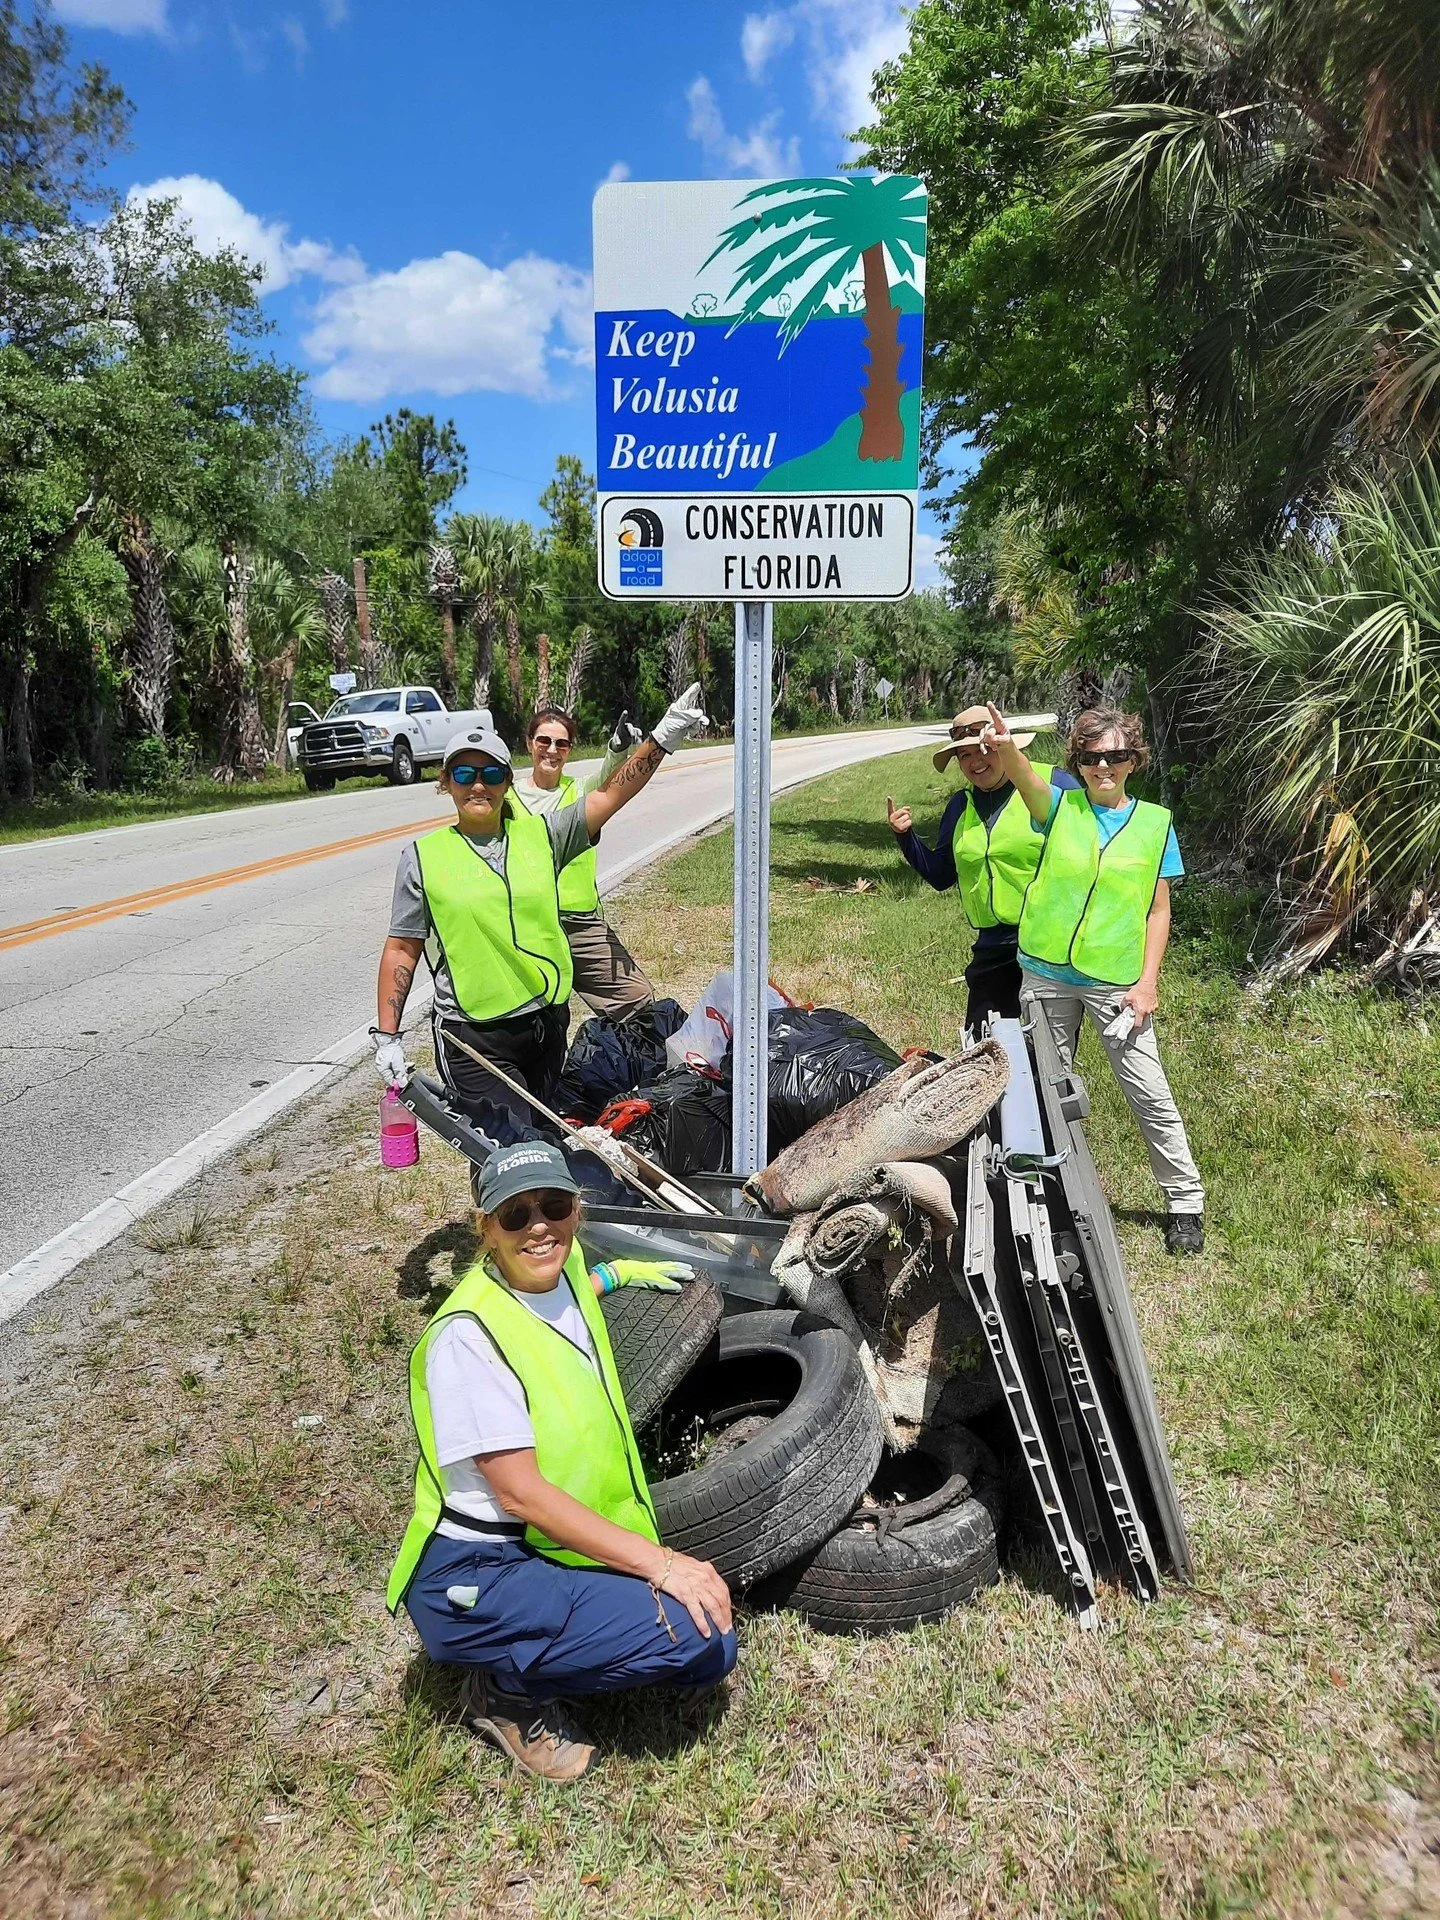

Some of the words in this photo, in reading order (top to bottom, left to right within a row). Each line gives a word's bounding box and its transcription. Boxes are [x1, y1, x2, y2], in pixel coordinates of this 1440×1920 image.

[606, 320, 696, 367] Keep
[611, 376, 739, 414] Volusia
[607, 432, 778, 480] Beautiful
[685, 503, 883, 540] CONSERVATION
[622, 551, 660, 564] adopt
[637, 565, 645, 574] a
[724, 554, 842, 590] FLORIDA
[626, 575, 655, 585] road
[497, 1154, 552, 1175] FLORIDA
